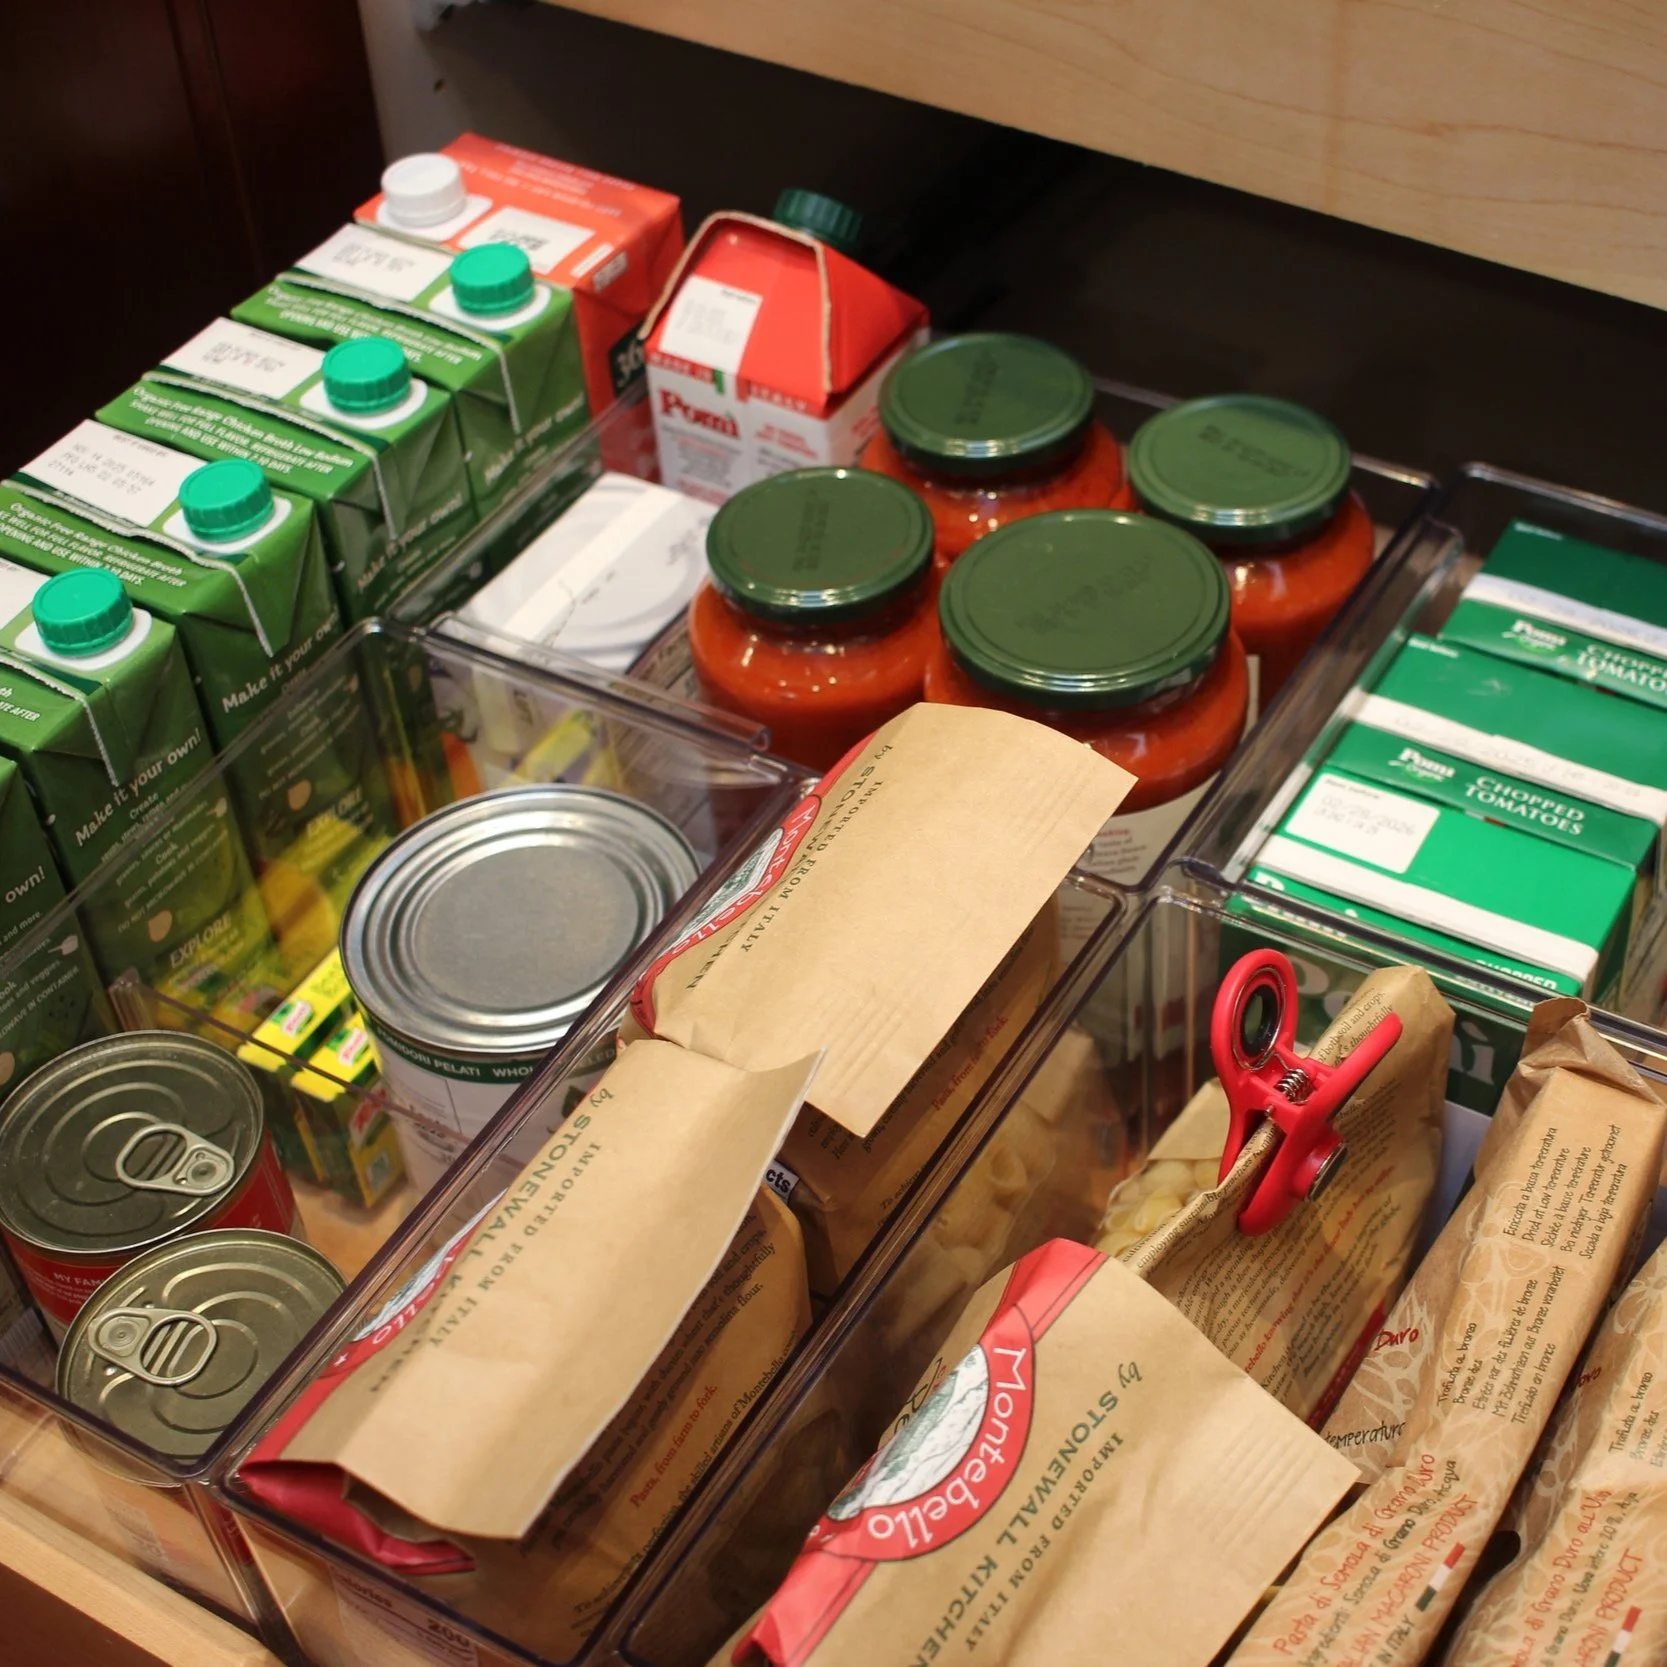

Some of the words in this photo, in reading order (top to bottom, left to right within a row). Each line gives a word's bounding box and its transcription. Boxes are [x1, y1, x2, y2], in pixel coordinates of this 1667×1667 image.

[170, 399, 192, 413] Free
[191, 406, 223, 422] Range
[221, 414, 265, 439] Chicken
[262, 433, 295, 451] Broth
[11, 502, 51, 526] Organic
[50, 522, 74, 536] Free
[73, 531, 108, 549] Range
[107, 545, 151, 565] Chicken
[150, 560, 183, 576] Broth
[157, 574, 188, 588] AFTER
[1576, 650, 1667, 695] TOMATO
[1586, 644, 1667, 678] CHOPP
[10, 706, 41, 721] AFTER
[221, 676, 268, 713] Make
[873, 744, 893, 760] by
[74, 802, 114, 847] Make
[113, 786, 130, 806] it
[129, 759, 163, 798] your
[167, 727, 202, 766] own!
[129, 792, 159, 821] Create
[1465, 782, 1584, 836] TOMATOES
[1476, 776, 1585, 822] CHOPPED
[817, 780, 883, 852] IMPORTED
[4, 865, 46, 904] own!
[671, 803, 816, 954] Montebello
[780, 858, 816, 900] FROM
[1, 926, 19, 942] and
[170, 912, 233, 969] EXPLORE
[740, 906, 780, 953] ITALY
[1363, 991, 1386, 1012] crops.
[434, 1060, 481, 1079] PELATI
[492, 1066, 534, 1079] WHO
[590, 1087, 615, 1108] by
[469, 1113, 592, 1259] STONEWALL
[524, 1143, 601, 1238] IMPORTED
[1503, 1202, 1527, 1236] Essiccata
[1520, 1171, 1539, 1193] bassa
[1554, 1191, 1574, 1213] basse
[1137, 1223, 1182, 1273] employing
[1521, 1220, 1542, 1242] Dried
[1579, 1231, 1600, 1260] Secada
[476, 1242, 524, 1293] FROM
[723, 1242, 776, 1299] thoughtfully
[429, 1296, 478, 1348] ITALY
[1374, 1326, 1420, 1352] Duro
[1456, 1322, 1478, 1351] bronzo
[1492, 1350, 1508, 1365] des
[1516, 1279, 1538, 1305] bronze
[1524, 1335, 1537, 1350] aus
[1526, 1306, 1549, 1334] Bronze
[1118, 1360, 1143, 1388] by
[1533, 1343, 1556, 1376] bronce
[703, 1418, 738, 1454] artisans
[737, 1354, 786, 1407] Montebello
[1452, 1374, 1476, 1404] Bronze
[628, 1472, 662, 1508] Pasta,
[651, 1445, 680, 1475] from
[670, 1421, 695, 1447] farm
[693, 1381, 721, 1410] fork.
[868, 1346, 1028, 1549] Montebello
[996, 1390, 1119, 1548] STONEWALL
[1051, 1432, 1124, 1530] IMPORTED
[1374, 1485, 1417, 1520] Grano
[1362, 1522, 1384, 1538] di
[1008, 1533, 1051, 1589] FROM
[1319, 1541, 1371, 1591] Semola
[1370, 1552, 1433, 1627] MACARONI
[1421, 1494, 1479, 1552] PRODUCT
[1532, 1573, 1565, 1613] Grano
[1552, 1537, 1583, 1570] Duro
[1308, 1592, 1333, 1610] di
[1595, 1548, 1643, 1621] PRODUCT
[965, 1592, 1010, 1653] ITALY
[1272, 1613, 1318, 1656] Pasta
[1385, 1614, 1415, 1651] ITALY
